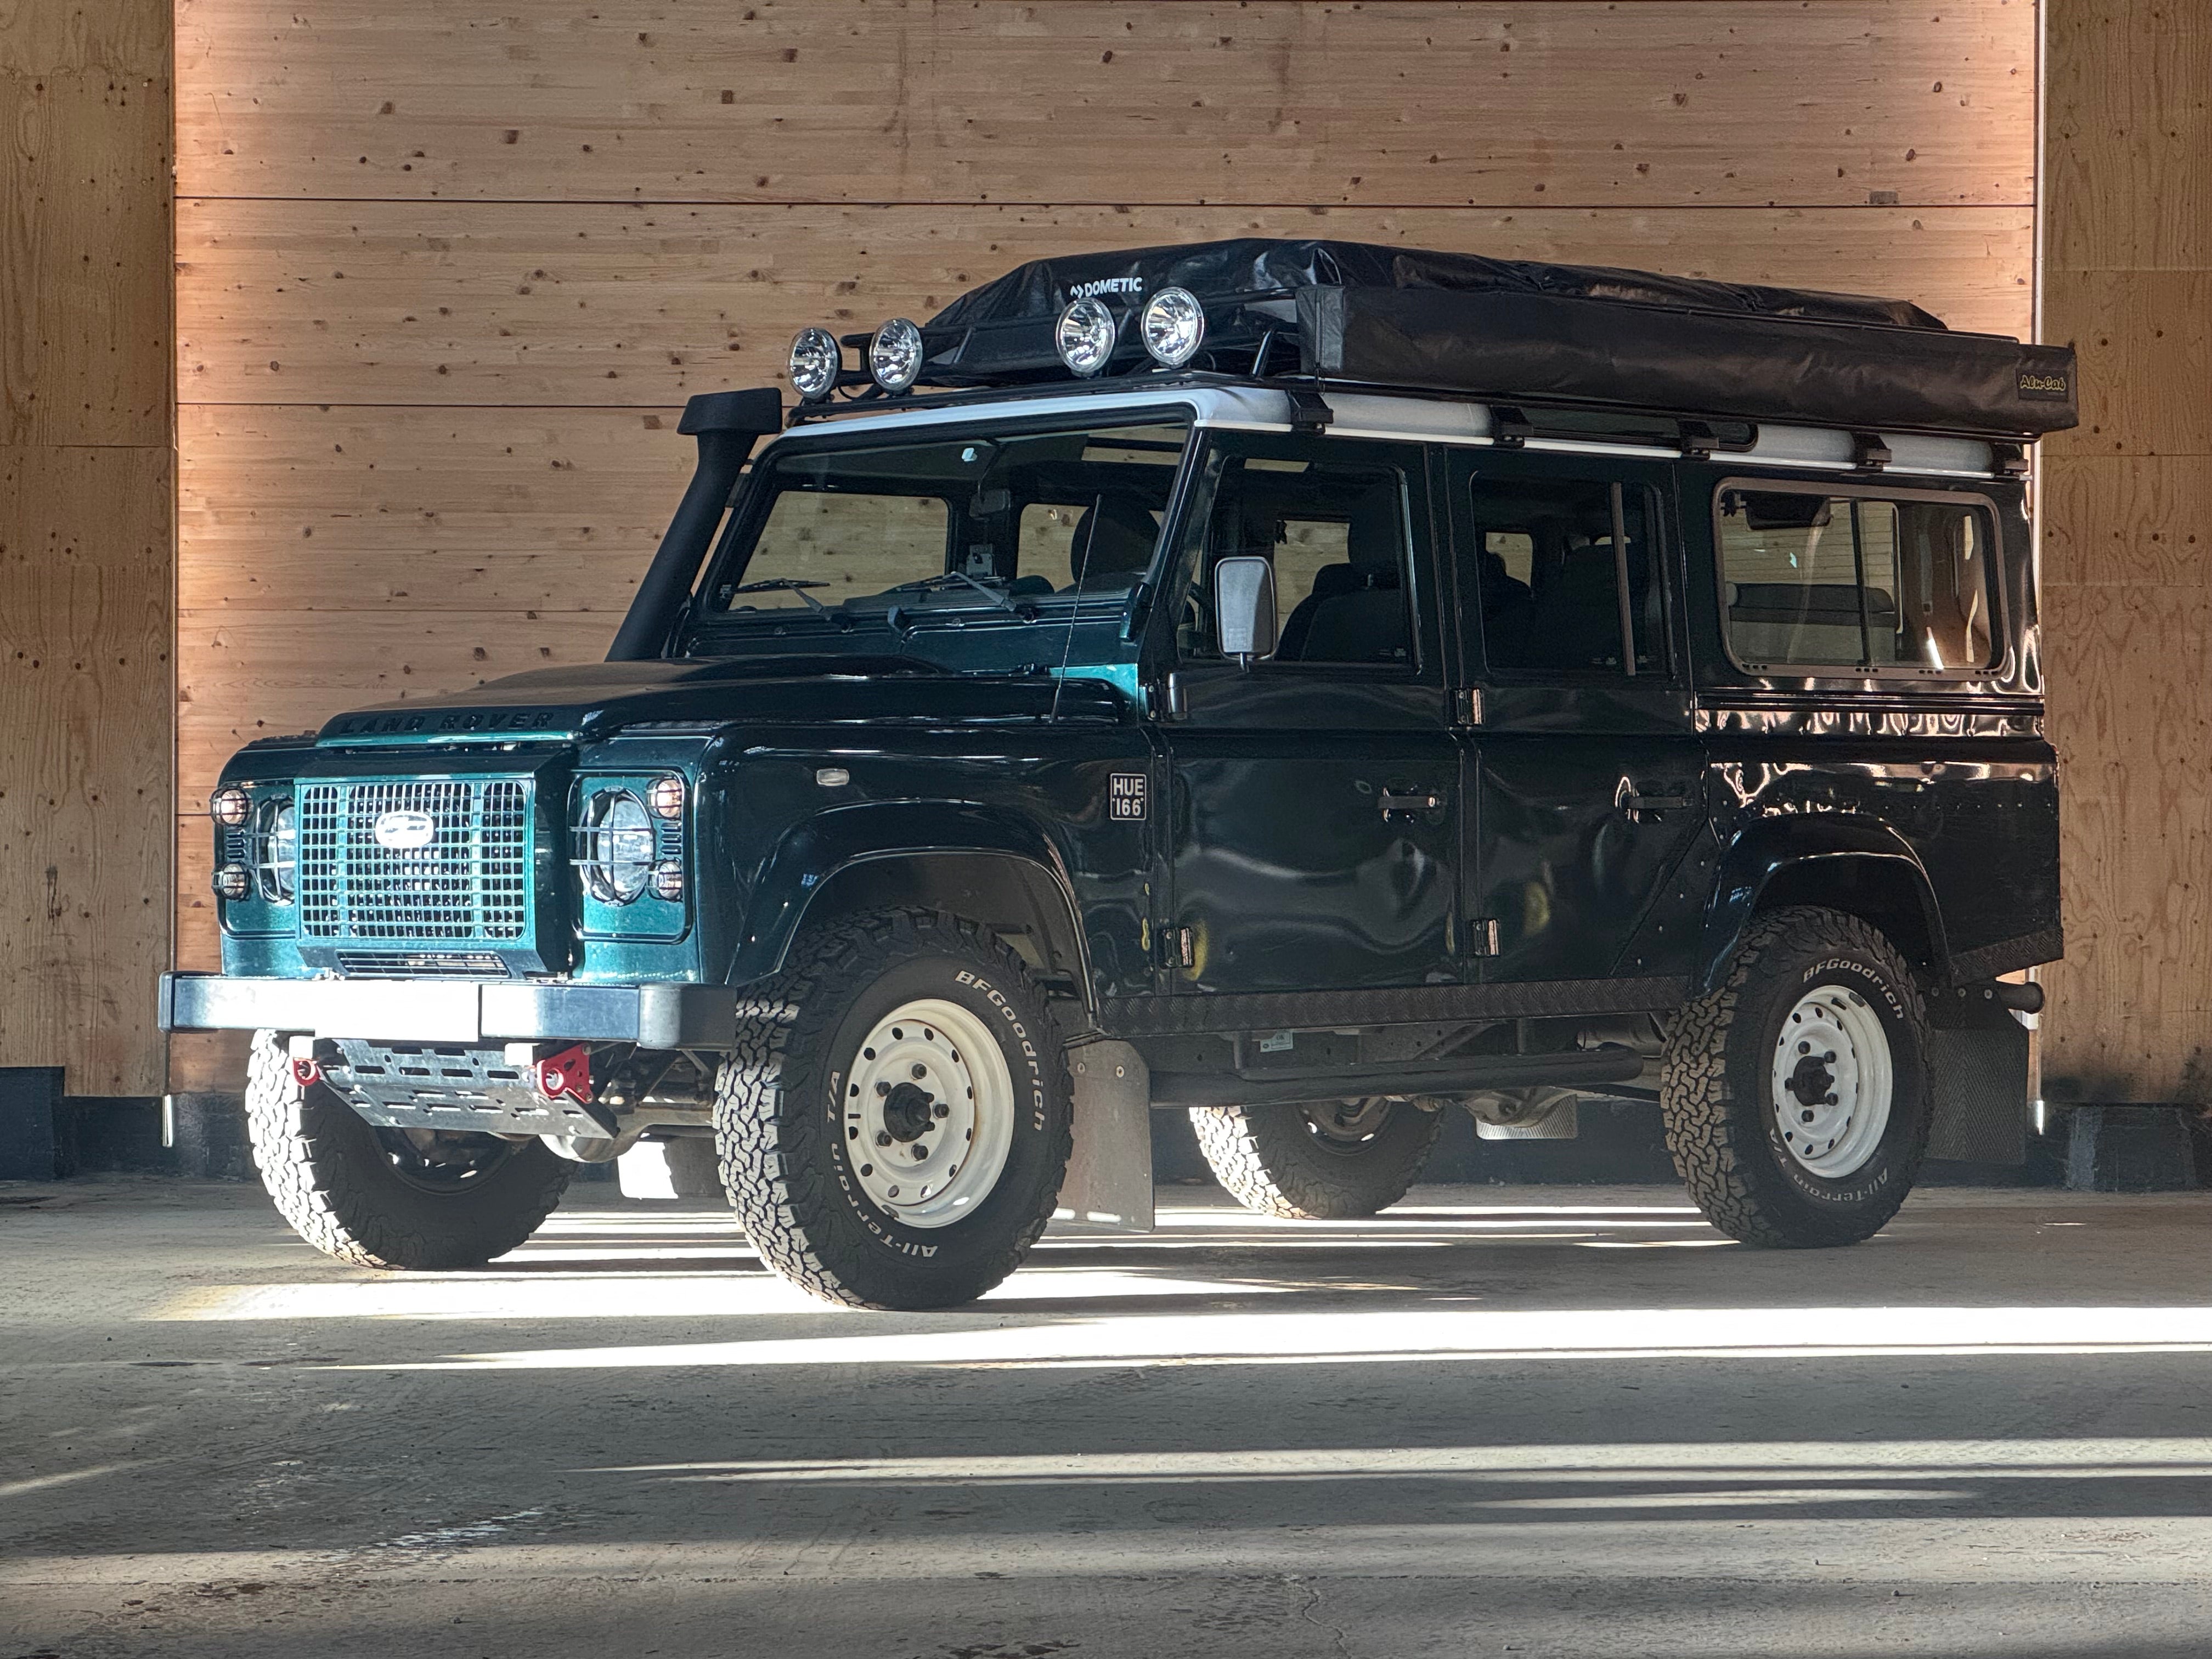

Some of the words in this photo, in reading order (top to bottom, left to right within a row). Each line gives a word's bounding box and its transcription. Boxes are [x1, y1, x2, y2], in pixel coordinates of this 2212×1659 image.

[1084, 277, 1143, 296] DOMETIC
[2020, 374, 2066, 391] Alu-Cab
[338, 715, 426, 735] LAND
[438, 713, 555, 731] ROVER
[1113, 777, 1144, 796] HUE
[1116, 798, 1141, 816] 166
[1803, 957, 1904, 1019] BFGoodrich
[955, 970, 1046, 1131] BFGoodrich
[827, 1071, 840, 1123] T/A
[831, 1143, 939, 1257] All-Terrain
